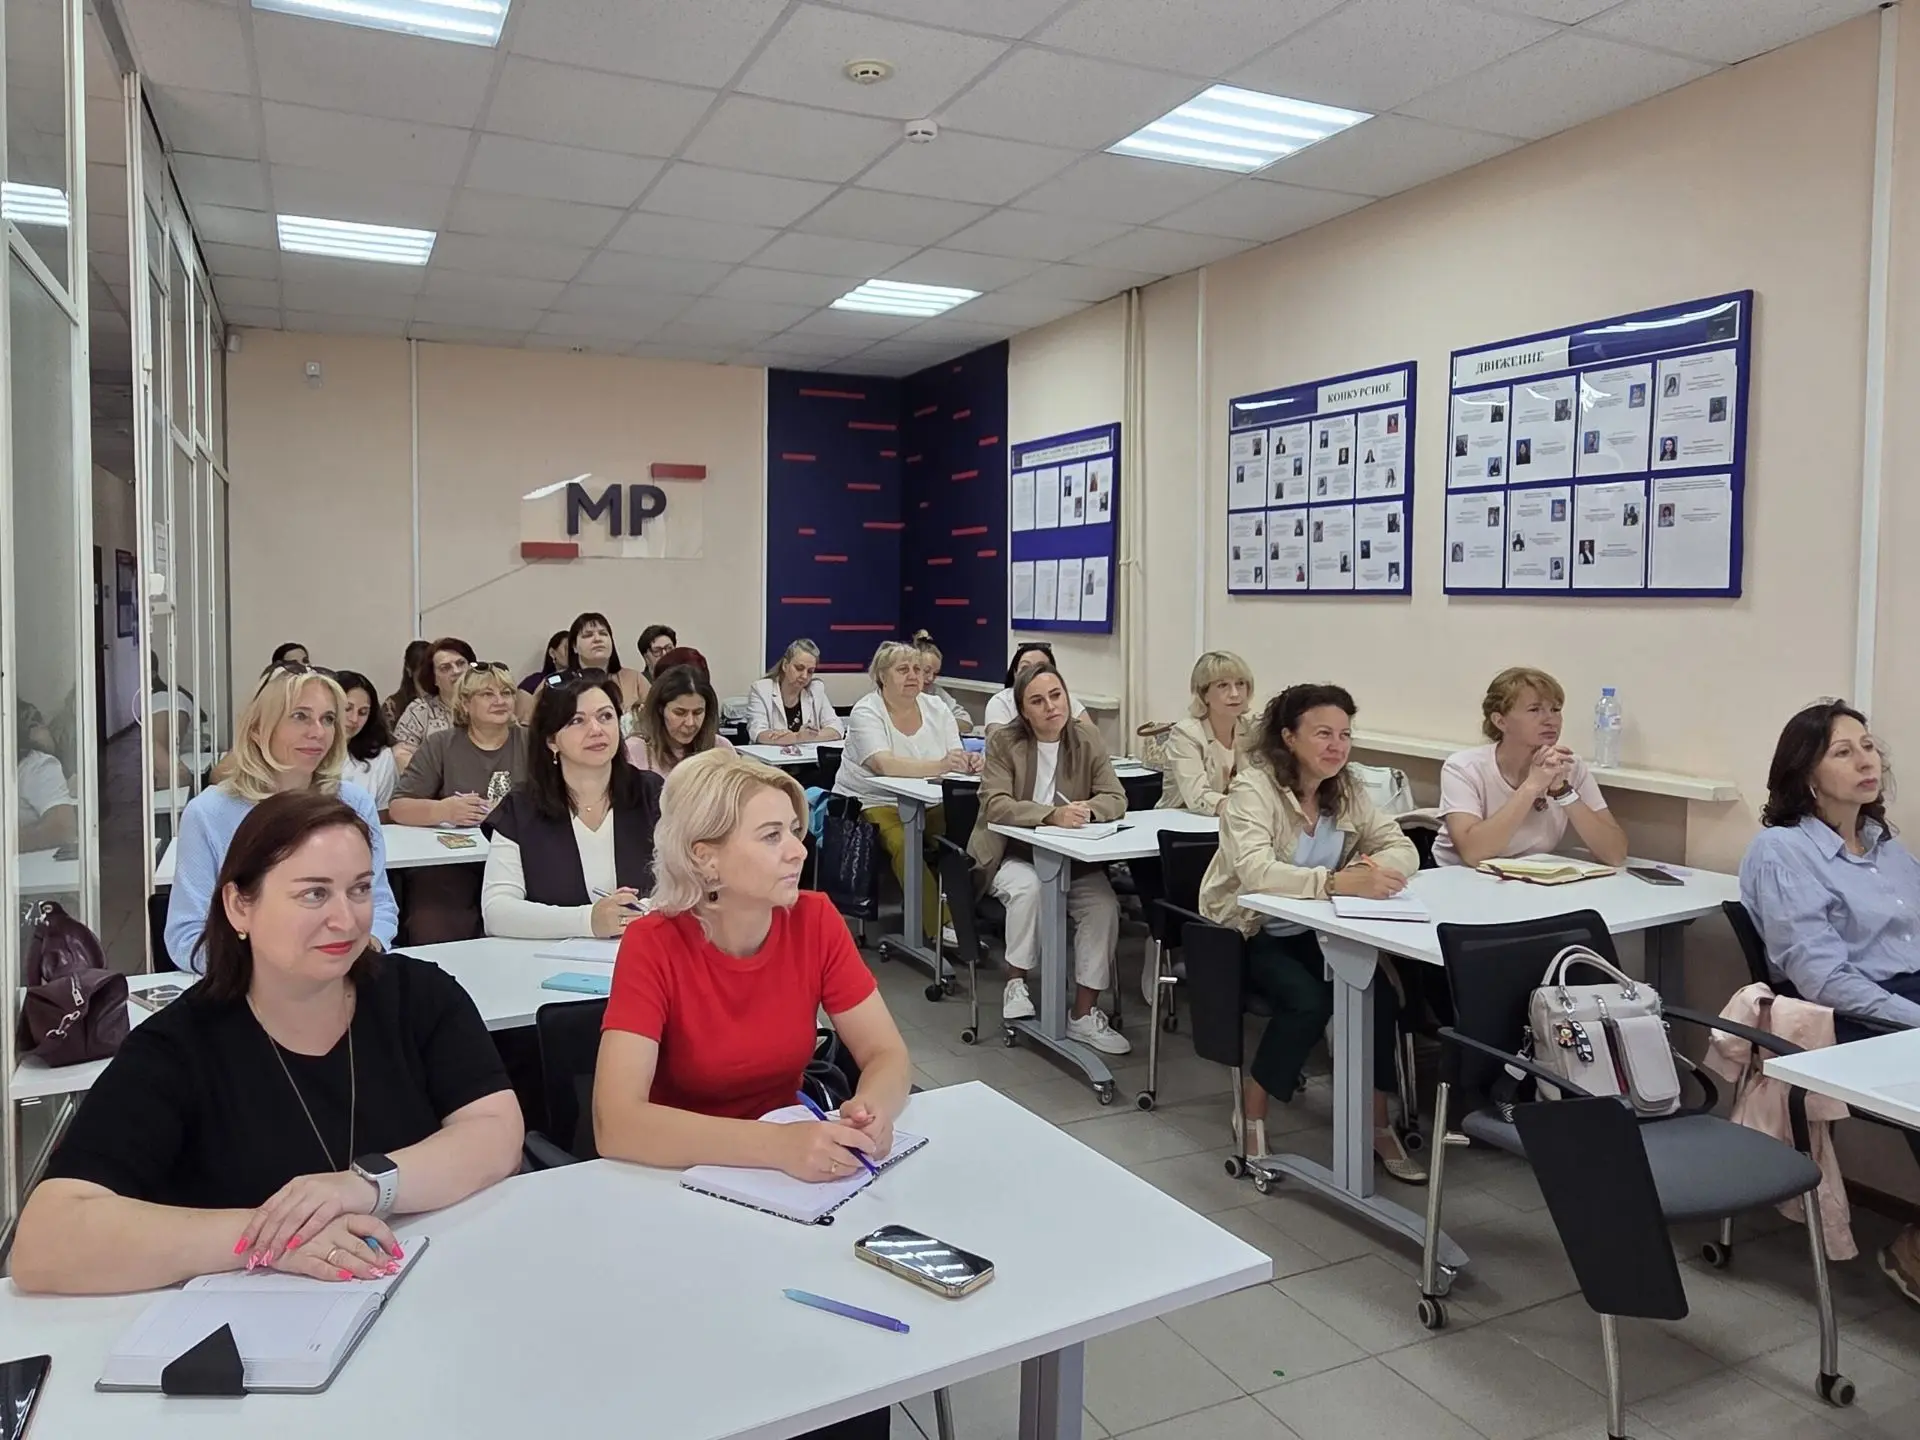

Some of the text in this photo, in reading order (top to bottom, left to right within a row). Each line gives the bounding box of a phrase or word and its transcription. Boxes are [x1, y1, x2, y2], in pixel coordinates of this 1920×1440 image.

[1475, 351, 1545, 375] ДВИЖЕНИЕ
[1327, 382, 1392, 404] КОНКУРСНОЕ
[566, 482, 668, 537] МР
